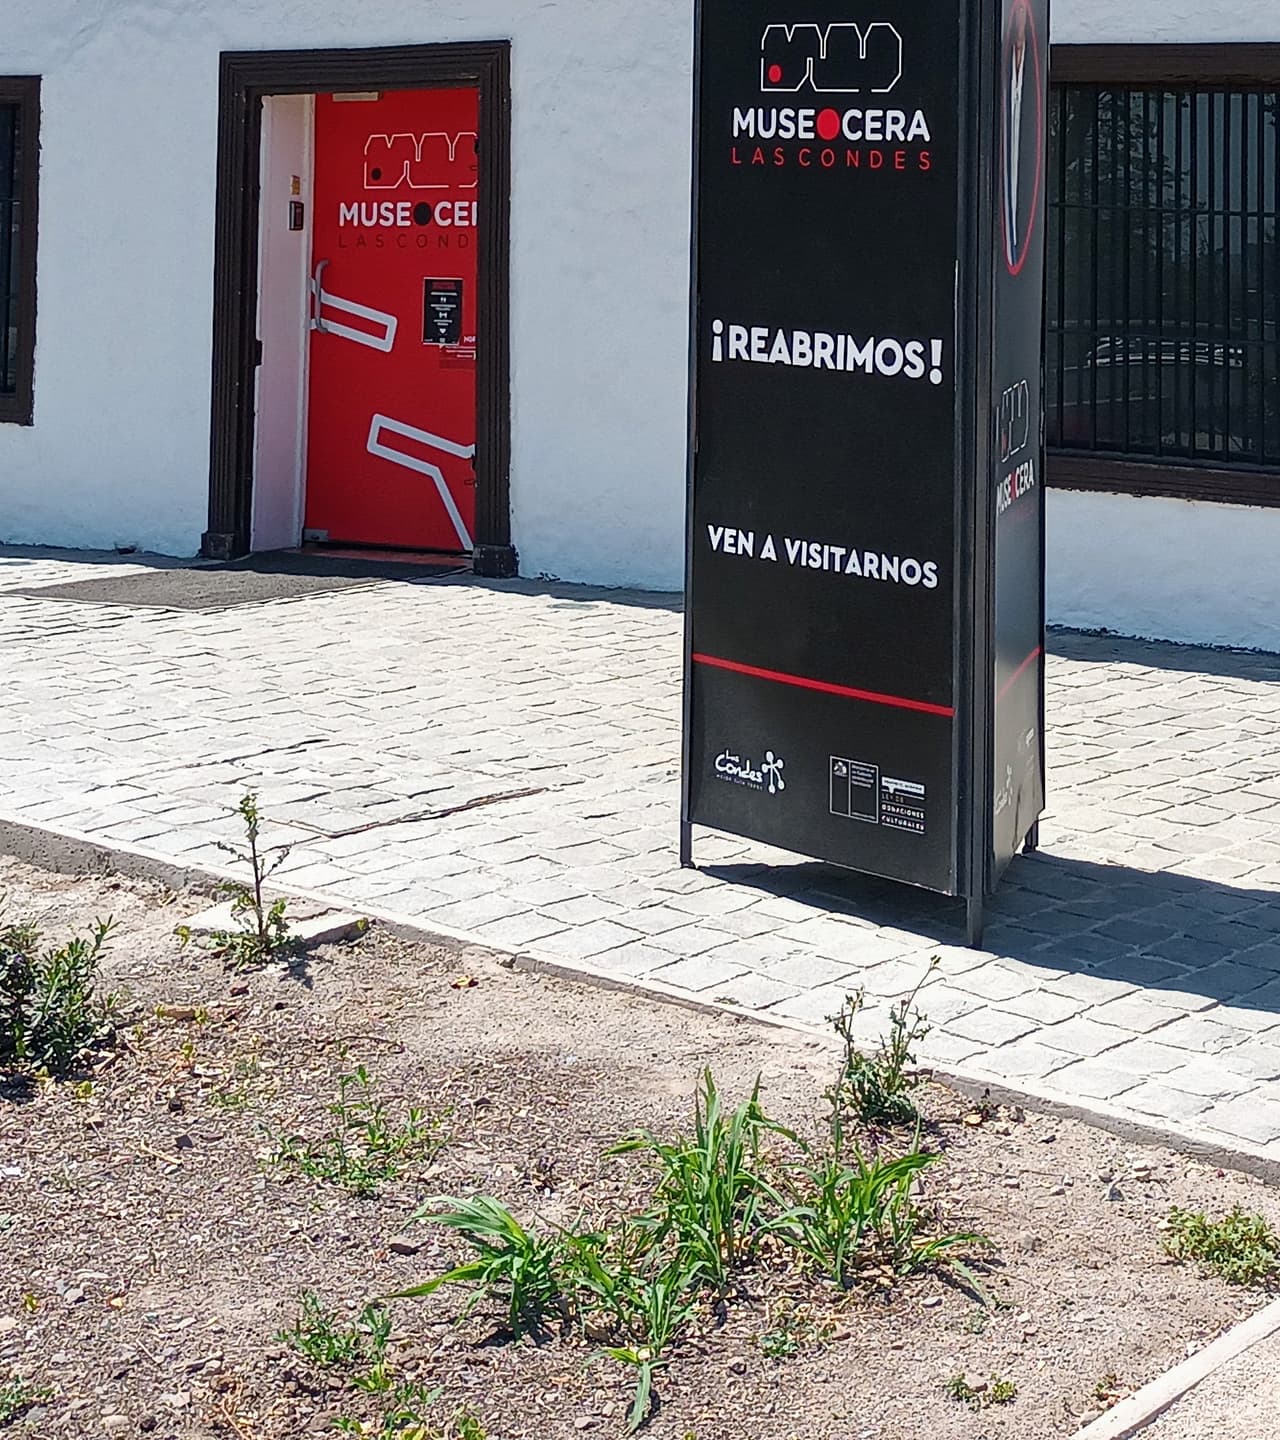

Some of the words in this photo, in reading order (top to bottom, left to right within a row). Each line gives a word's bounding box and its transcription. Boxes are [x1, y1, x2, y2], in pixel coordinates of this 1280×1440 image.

[730, 146, 785, 166] LAS
[798, 147, 932, 170] CONDES
[338, 233, 385, 249] LAS
[395, 233, 470, 249] COND
[711, 318, 944, 385] ¡REABRIMOS!
[707, 524, 754, 558] VEN
[759, 534, 777, 561] A
[784, 537, 939, 589] VISITARNOS
[715, 753, 763, 783] Condes
